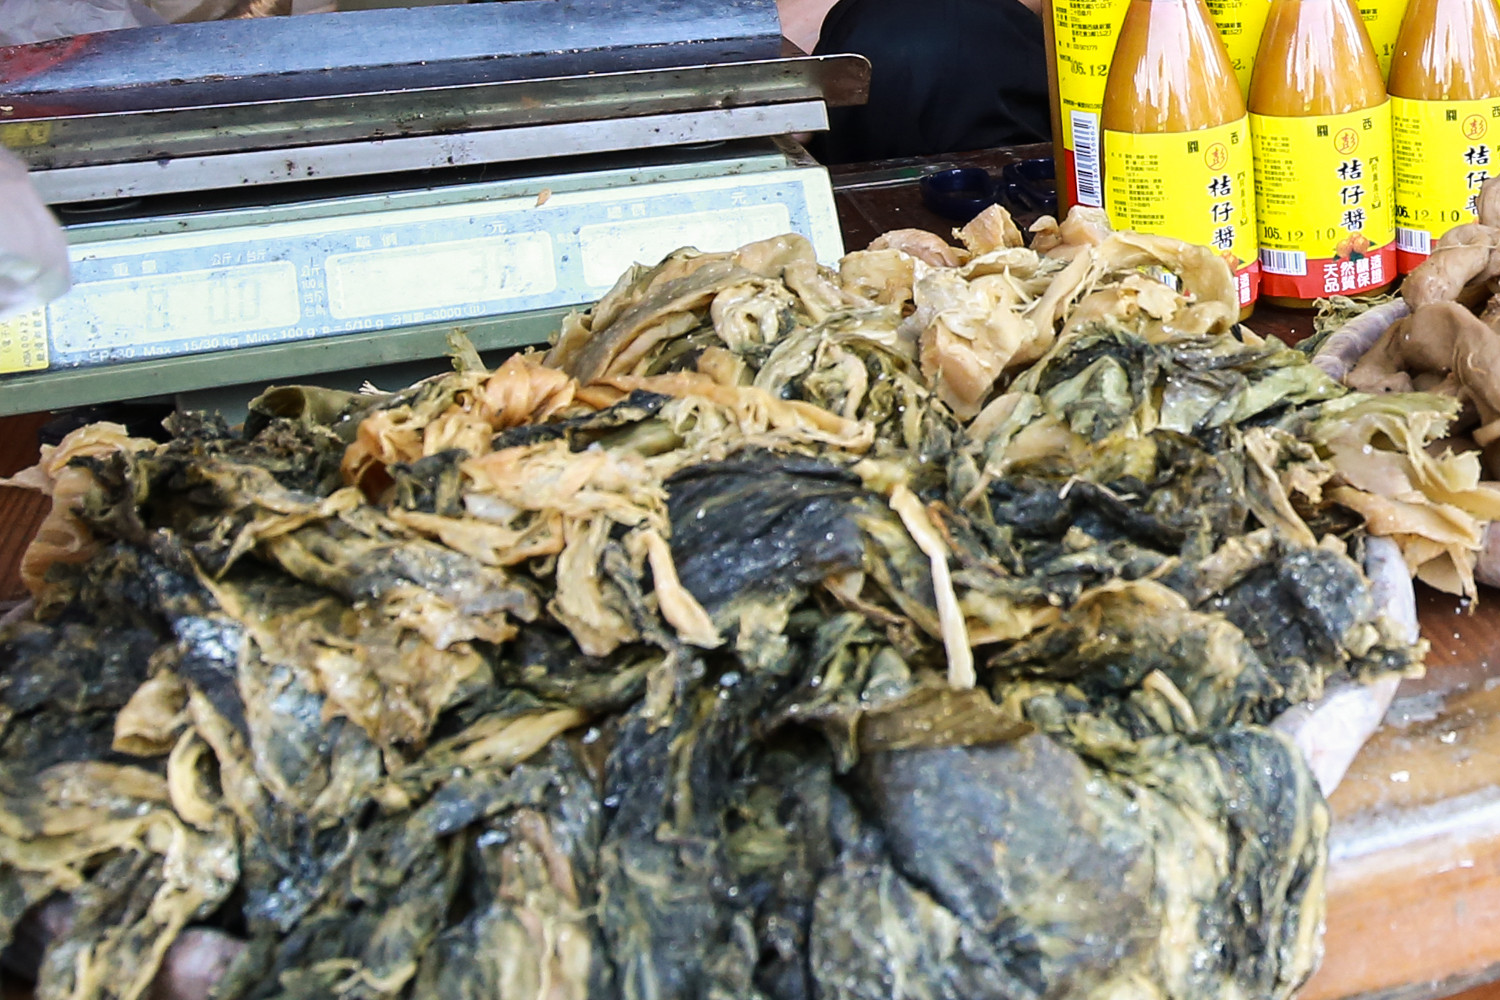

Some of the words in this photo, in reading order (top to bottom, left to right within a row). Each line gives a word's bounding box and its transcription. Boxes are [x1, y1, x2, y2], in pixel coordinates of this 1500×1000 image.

[1362, 117, 1373, 131] 西
[1230, 131, 1239, 145] 西
[1337, 159, 1366, 231] 桔仔醬
[1207, 174, 1236, 250] 桔仔醬
[1323, 254, 1383, 279] 天然釀造
[143, 344, 171, 357] Max
[222, 335, 239, 349] kg
[245, 332, 270, 345] Min
[280, 327, 303, 340] 100
